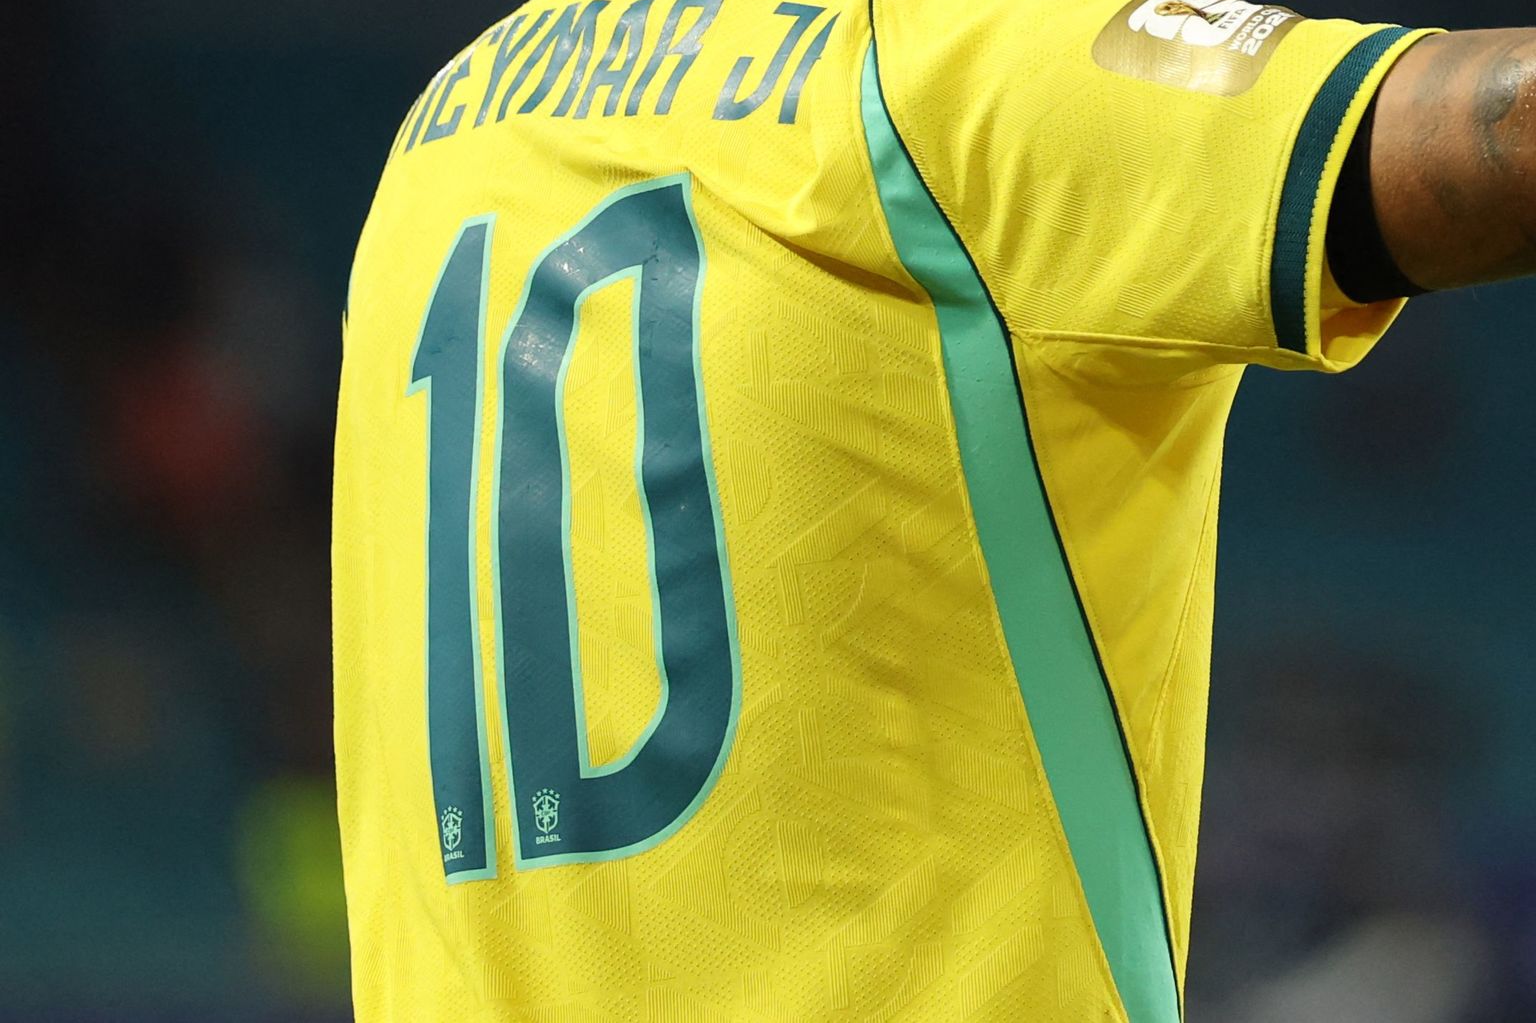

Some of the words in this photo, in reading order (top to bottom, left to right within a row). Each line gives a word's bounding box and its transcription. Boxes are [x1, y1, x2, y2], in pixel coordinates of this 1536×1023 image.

[1218, 9, 1246, 29] FIFA
[1228, 15, 1264, 50] WORLD
[406, 173, 743, 884] 10
[535, 834, 561, 845] BRASIL
